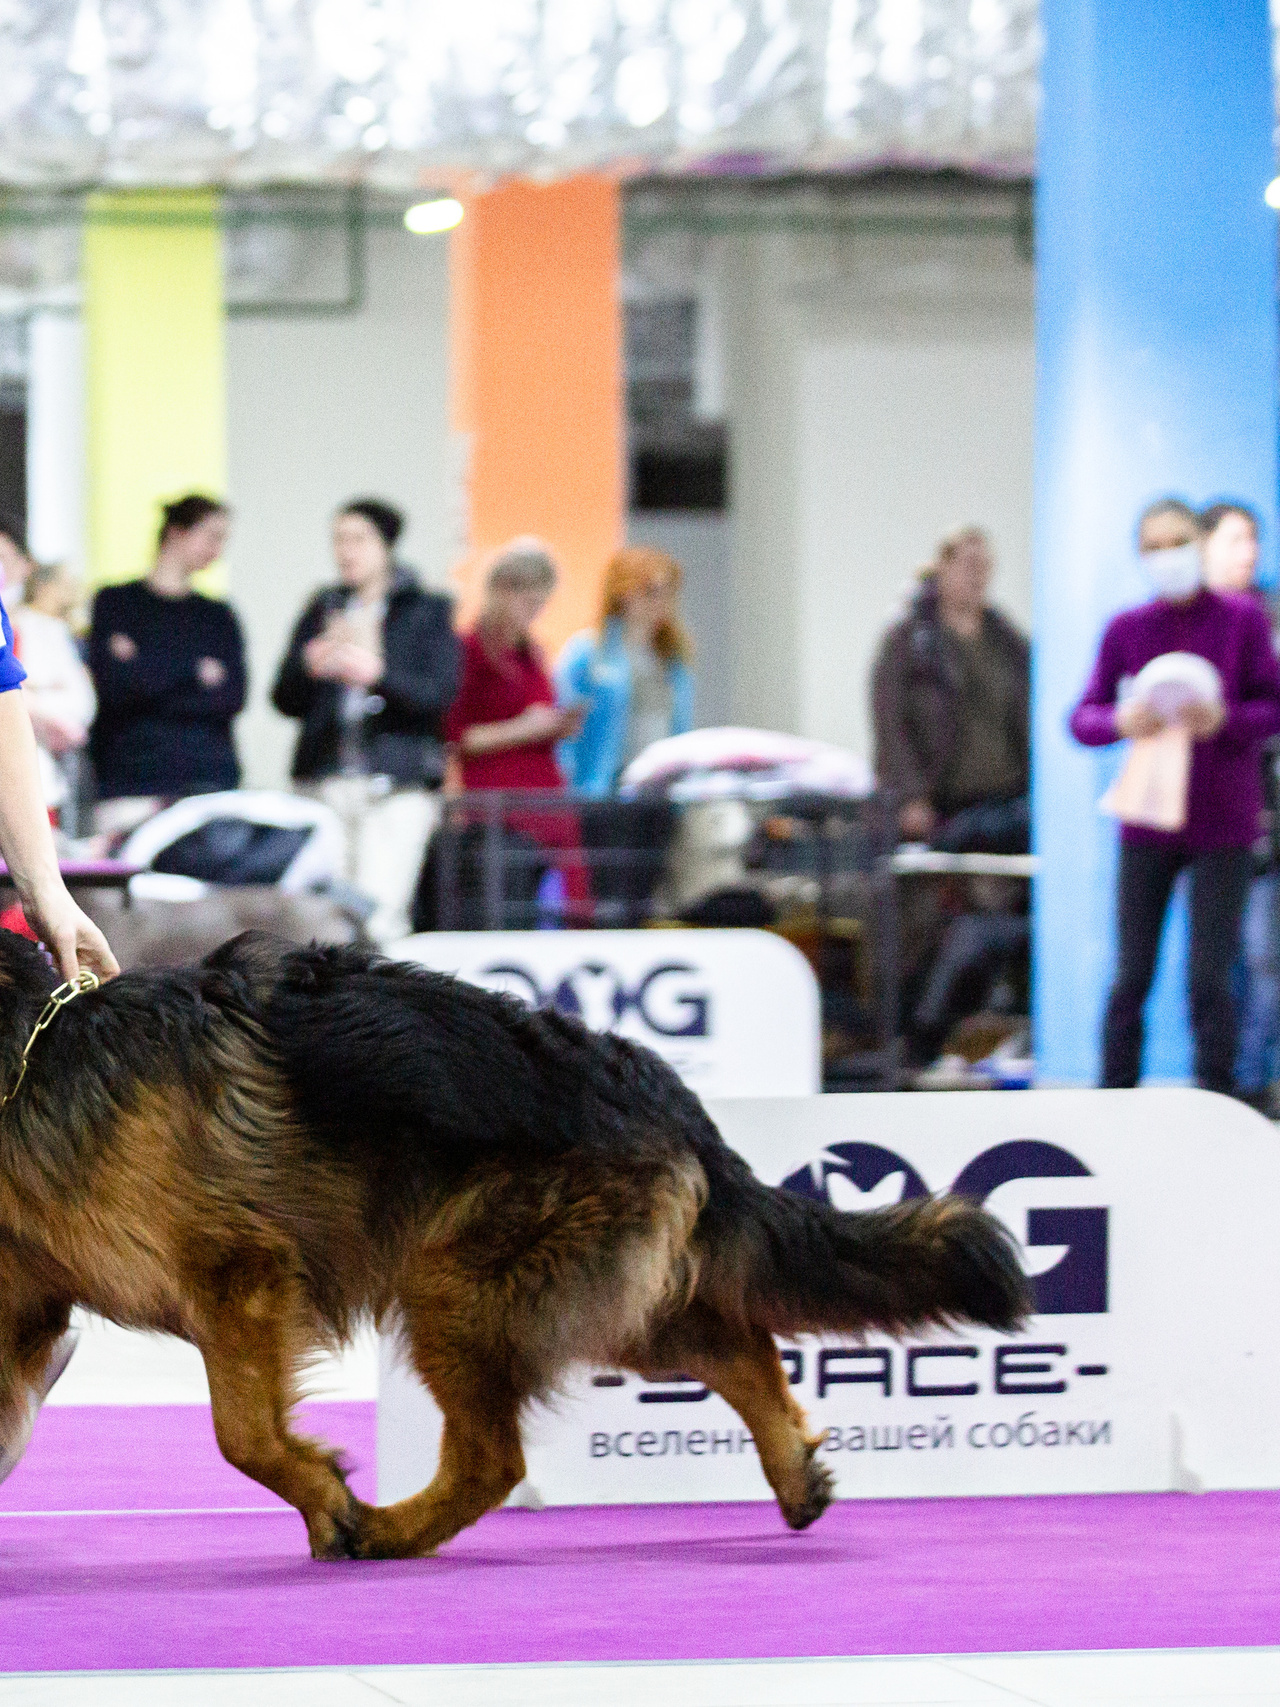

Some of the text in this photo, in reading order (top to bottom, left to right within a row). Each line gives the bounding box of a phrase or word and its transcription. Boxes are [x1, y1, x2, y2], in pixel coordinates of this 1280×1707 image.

[590, 1411, 1113, 1458] вселенн вашей собаки
